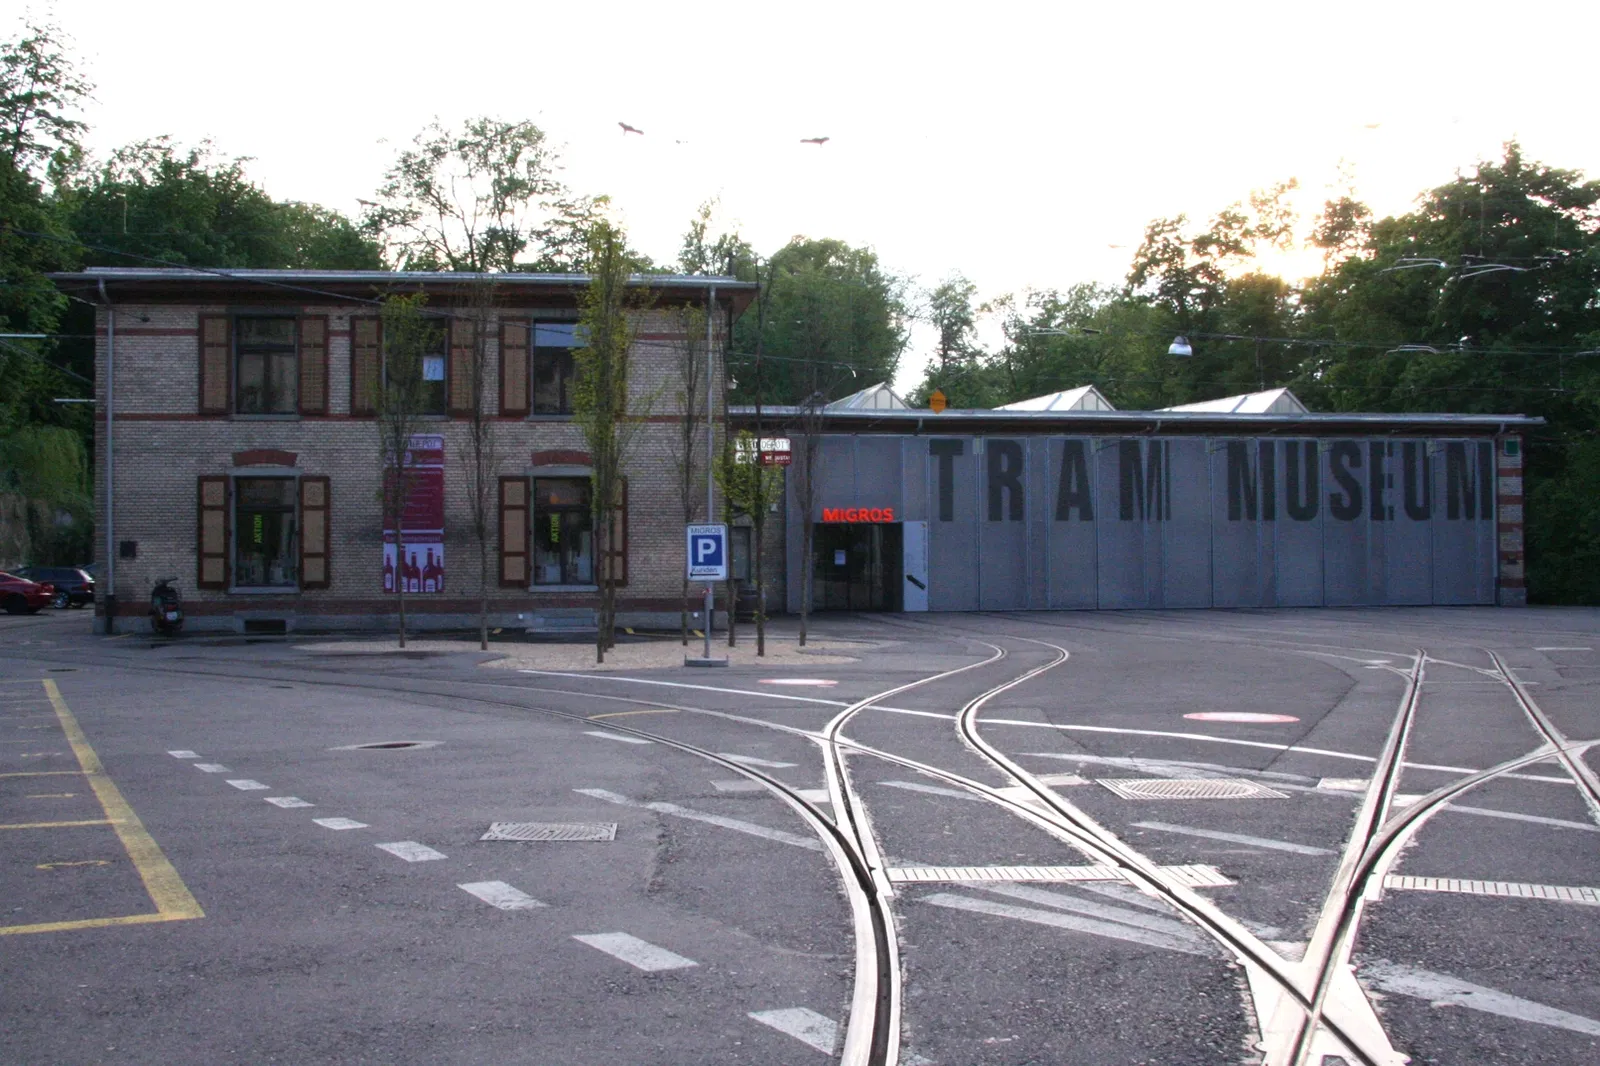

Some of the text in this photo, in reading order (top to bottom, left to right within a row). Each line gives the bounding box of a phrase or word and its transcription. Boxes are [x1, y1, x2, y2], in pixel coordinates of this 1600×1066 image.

[929, 438, 1493, 523] TRAM MUSEUM
[822, 507, 894, 523] MIGROS
[253, 514, 263, 544] AKTION
[697, 538, 717, 563] P
